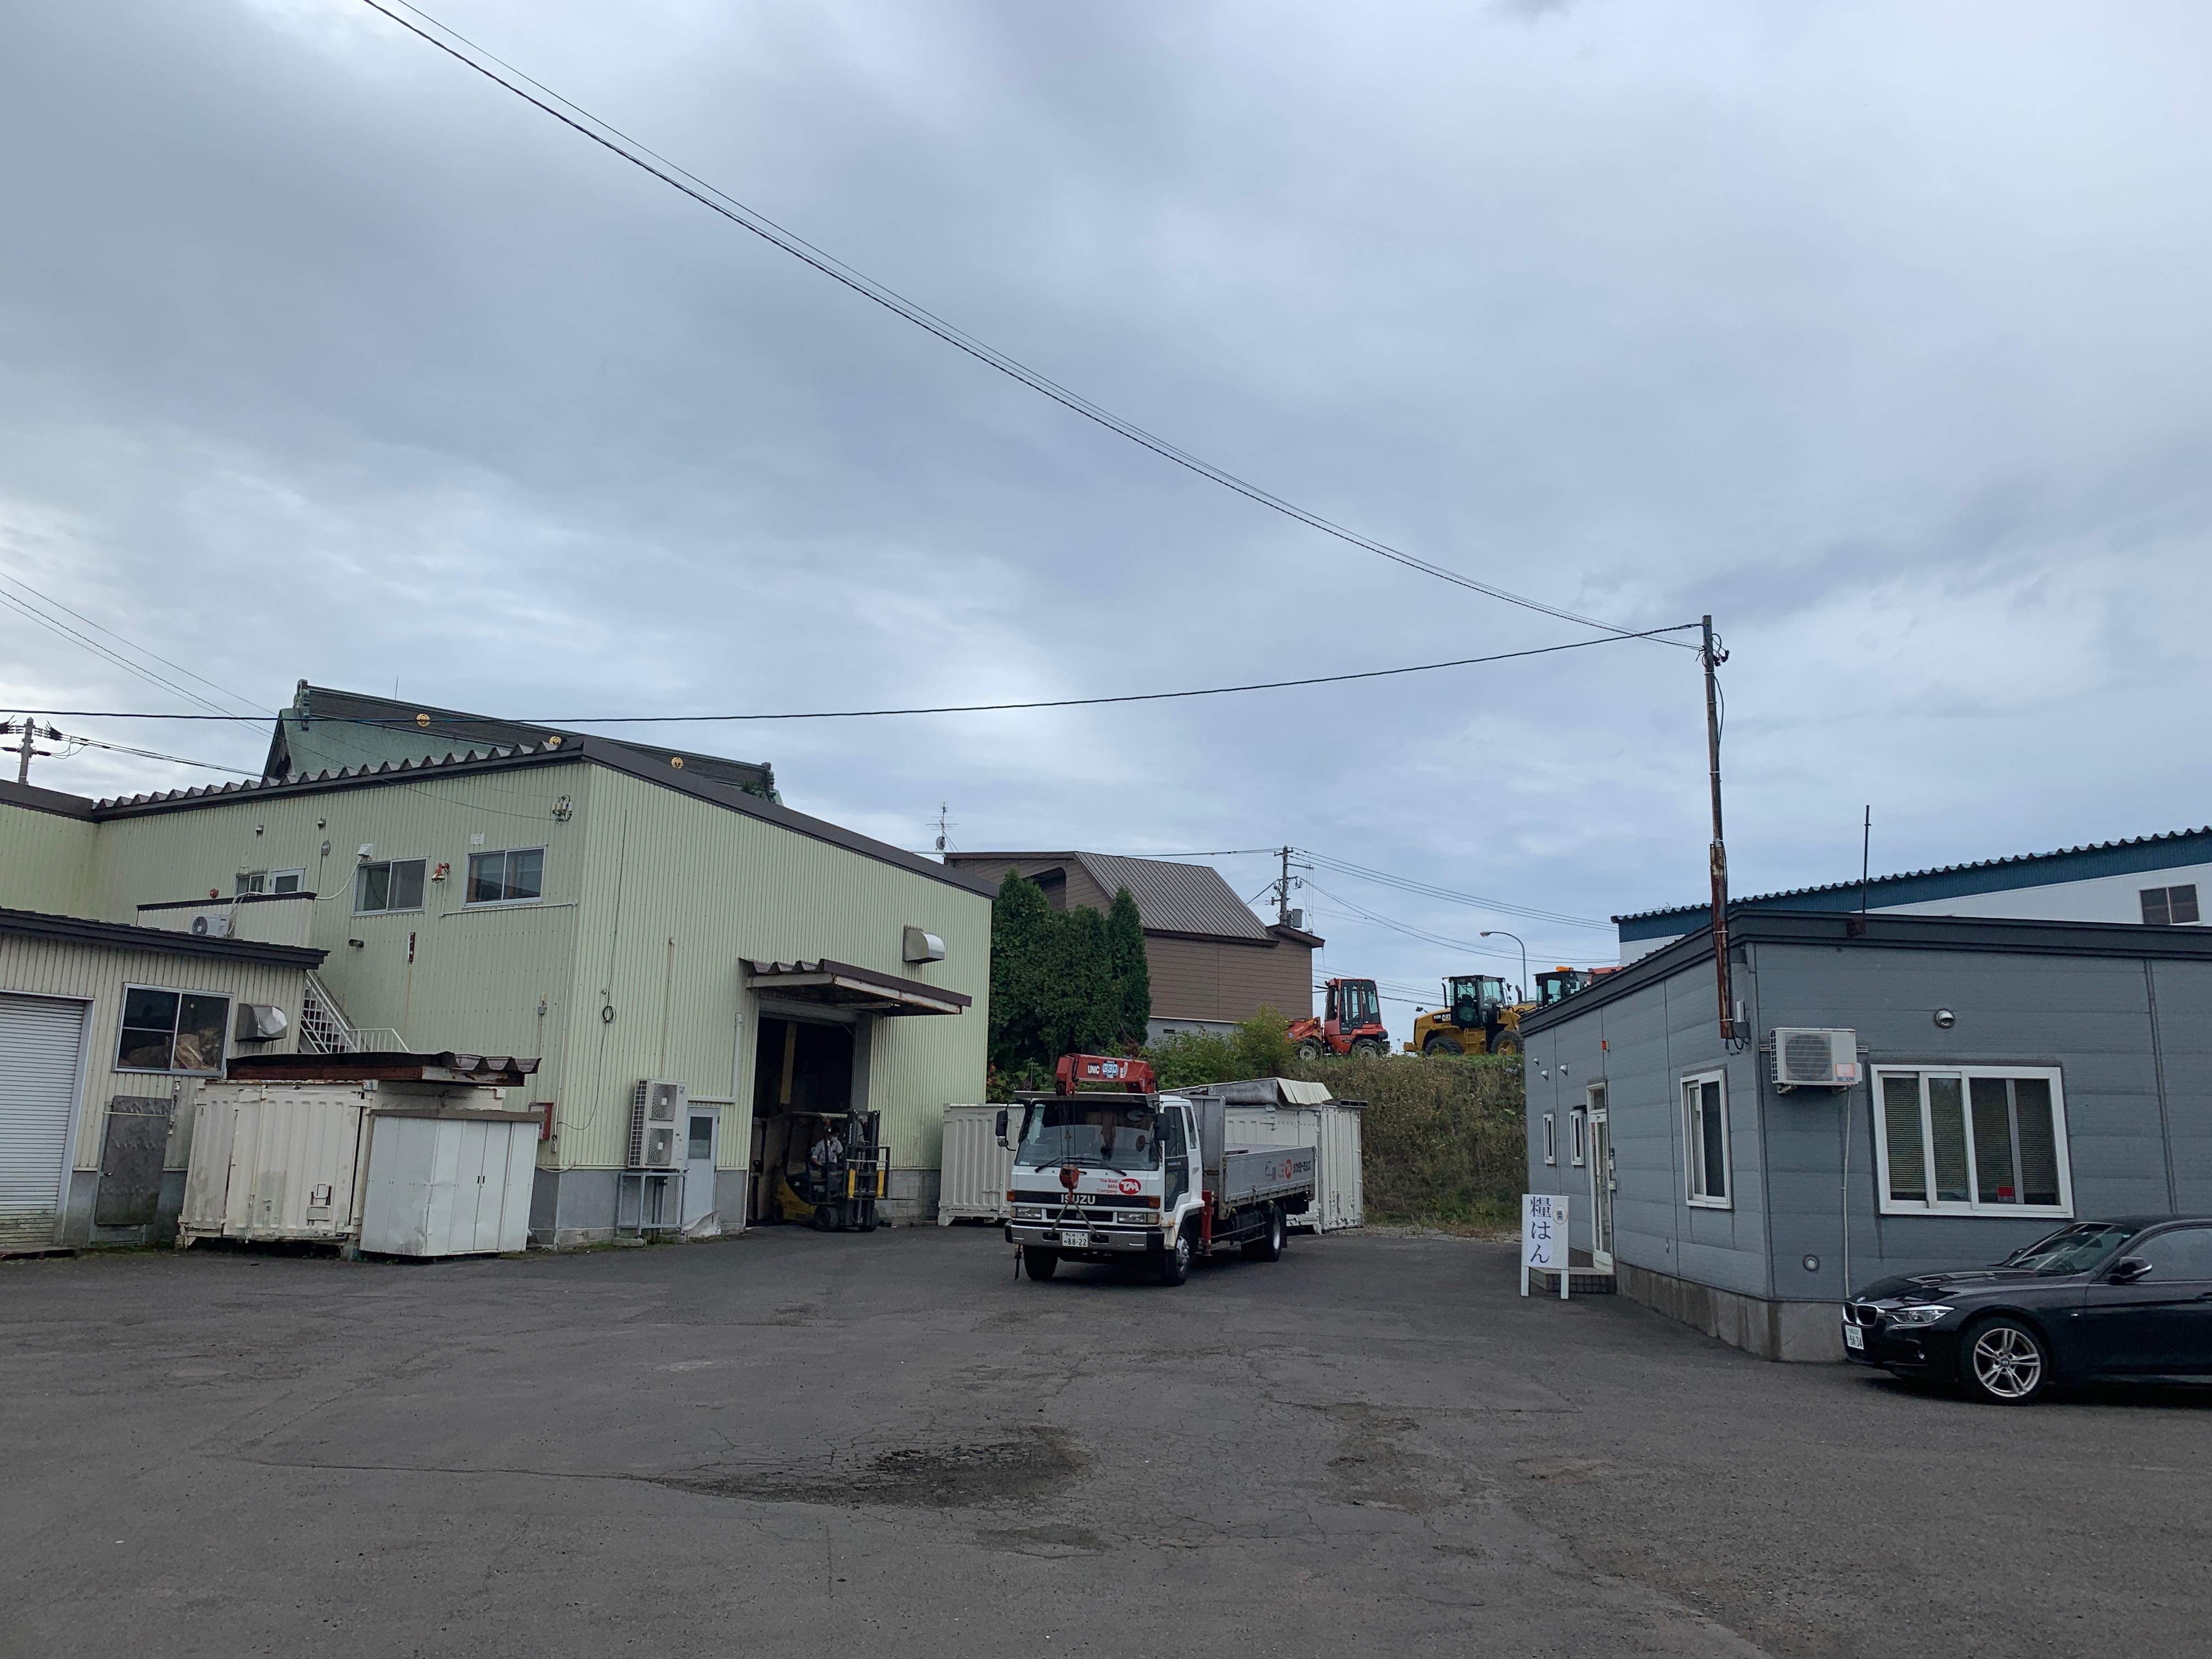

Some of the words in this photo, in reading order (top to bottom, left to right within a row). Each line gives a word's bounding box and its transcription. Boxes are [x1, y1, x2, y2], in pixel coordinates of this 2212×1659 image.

[1087, 1065, 1100, 1075] UNIC
[1060, 1194, 1096, 1205] ISUZU
[1530, 1196, 1551, 1263] 糧はん
